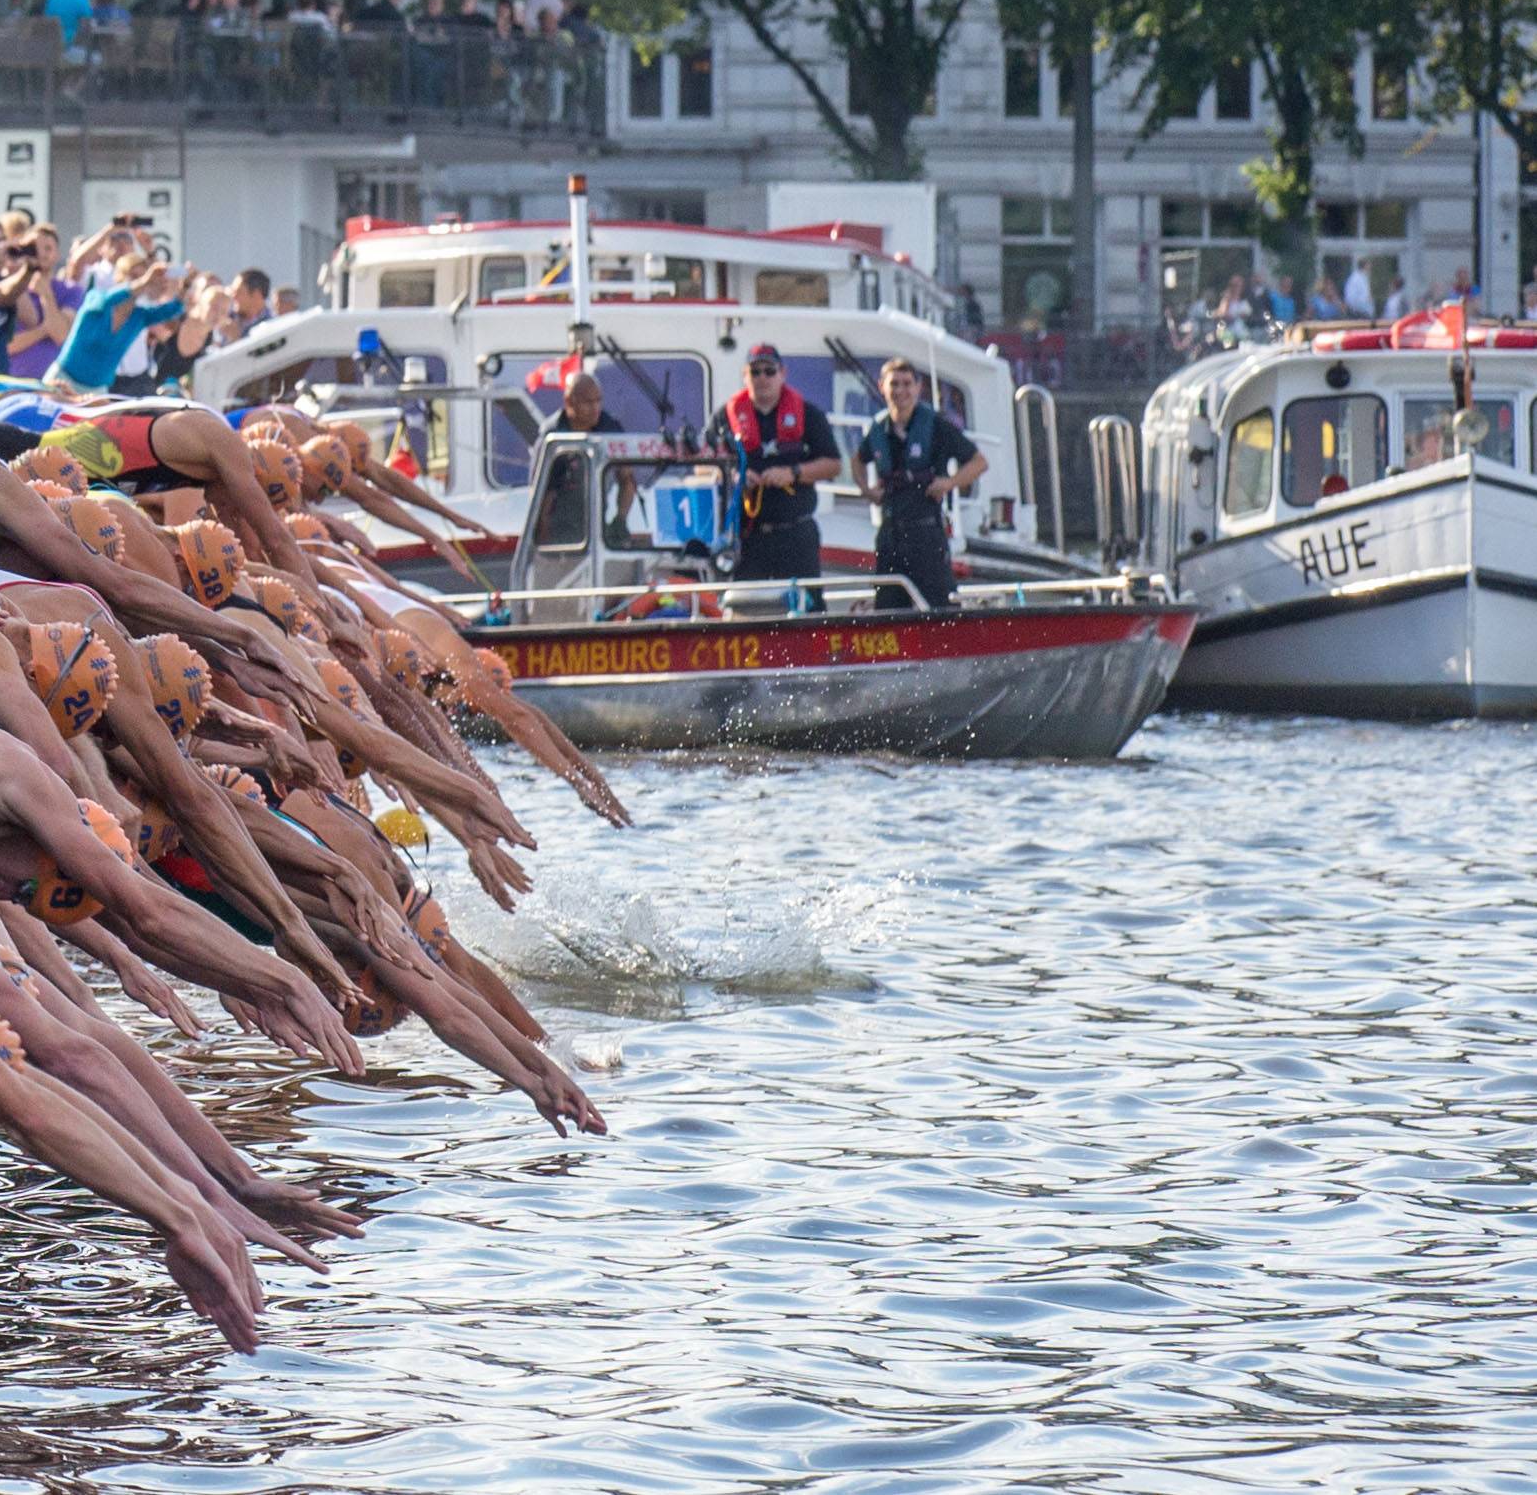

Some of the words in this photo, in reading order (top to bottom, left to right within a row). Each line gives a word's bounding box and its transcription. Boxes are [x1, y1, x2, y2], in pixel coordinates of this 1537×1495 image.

[1299, 520, 1378, 584] AUE
[197, 567, 224, 600] 38
[528, 638, 671, 675] HAMBURG
[714, 635, 762, 669] 112
[63, 689, 94, 731] 24
